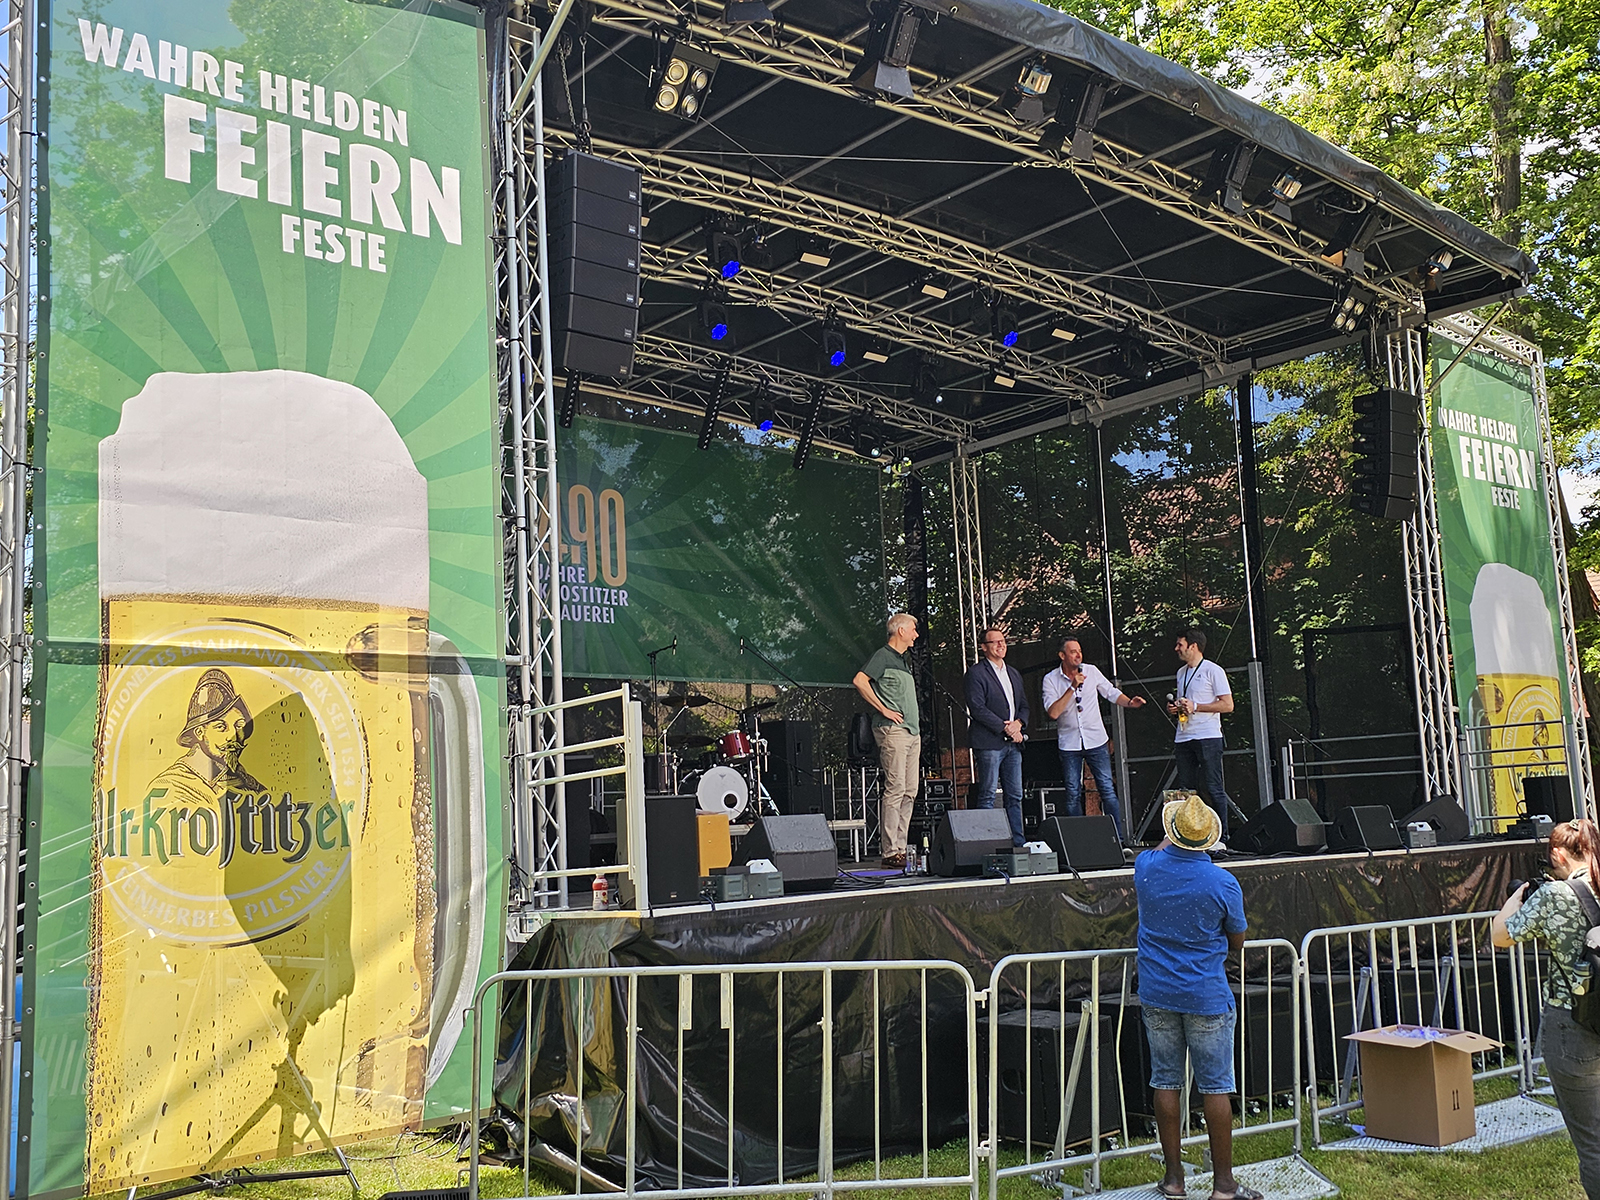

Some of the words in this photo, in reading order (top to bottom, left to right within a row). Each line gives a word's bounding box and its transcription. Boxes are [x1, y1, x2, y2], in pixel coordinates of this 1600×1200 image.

[77, 18, 245, 103] WAHRE
[259, 69, 409, 147] HELDEN
[163, 93, 463, 246] FEIERN
[281, 213, 387, 273] FESTE
[1479, 416, 1519, 445] HELDEN
[1458, 435, 1538, 491] FEIERN
[1491, 486, 1521, 511] FESTE
[539, 583, 629, 607] KOSTITZER
[540, 603, 615, 624] AUEREI
[181, 637, 333, 704] BRAUHANDWERK
[326, 702, 350, 741] SEIT
[340, 742, 356, 787] 1534
[115, 866, 236, 928] FEINHERBES
[244, 859, 333, 923] PILSNER
